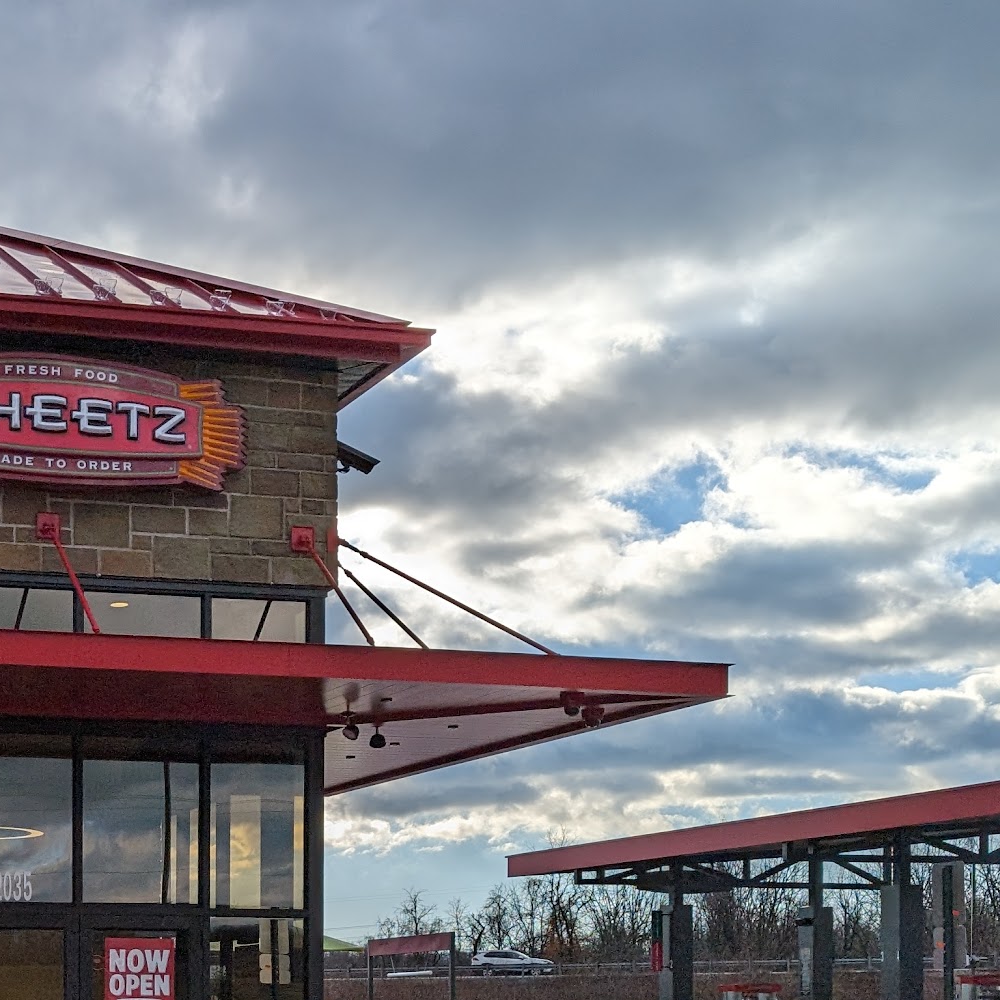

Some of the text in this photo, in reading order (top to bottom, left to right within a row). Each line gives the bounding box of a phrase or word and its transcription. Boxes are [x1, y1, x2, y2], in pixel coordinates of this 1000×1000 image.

[4, 364, 119, 384] FRESH FOOD
[45, 458, 68, 469] TO
[77, 459, 133, 472] ORDER
[109, 948, 171, 974] NOW
[109, 974, 171, 996] OPEN
